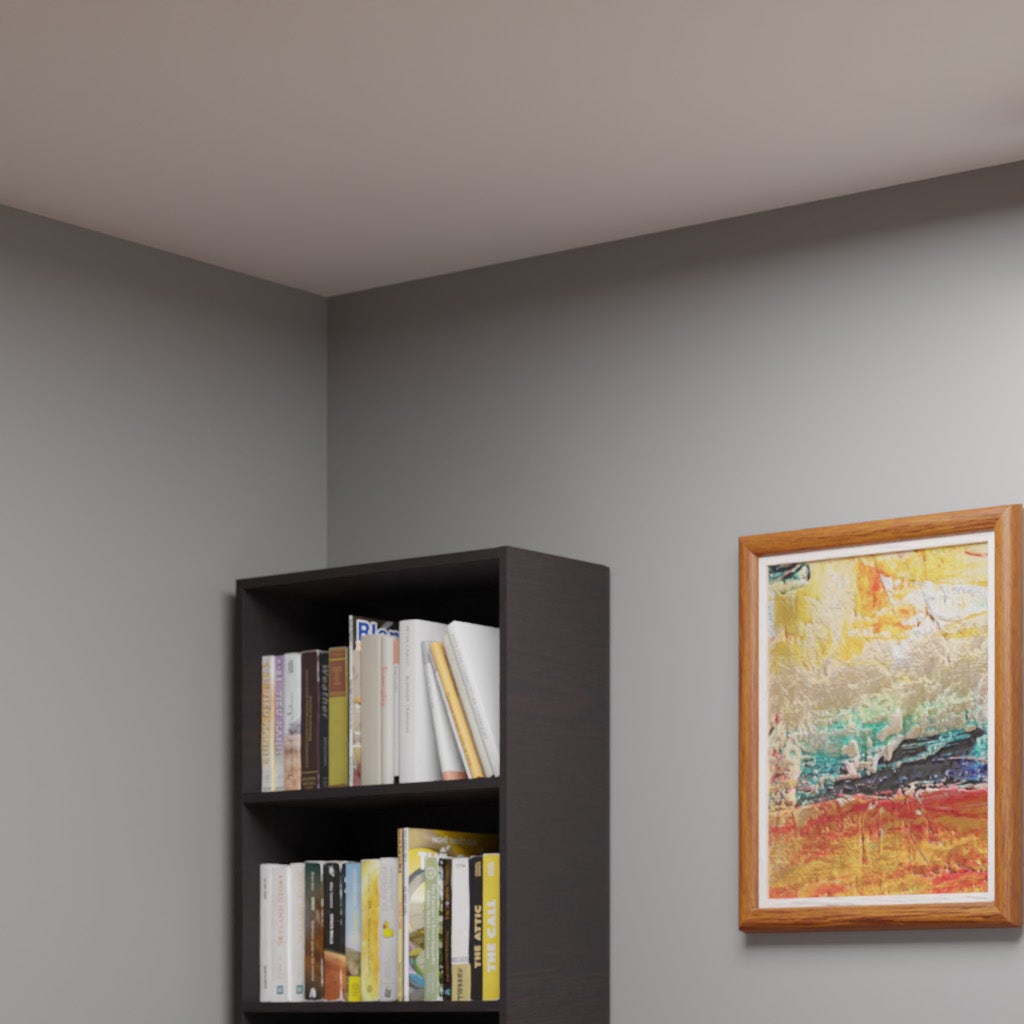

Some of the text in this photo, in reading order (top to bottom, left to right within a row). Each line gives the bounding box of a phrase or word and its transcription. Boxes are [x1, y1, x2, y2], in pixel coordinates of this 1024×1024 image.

[474, 905, 483, 969] THE ATTIC
[487, 899, 498, 973] THE CALL
